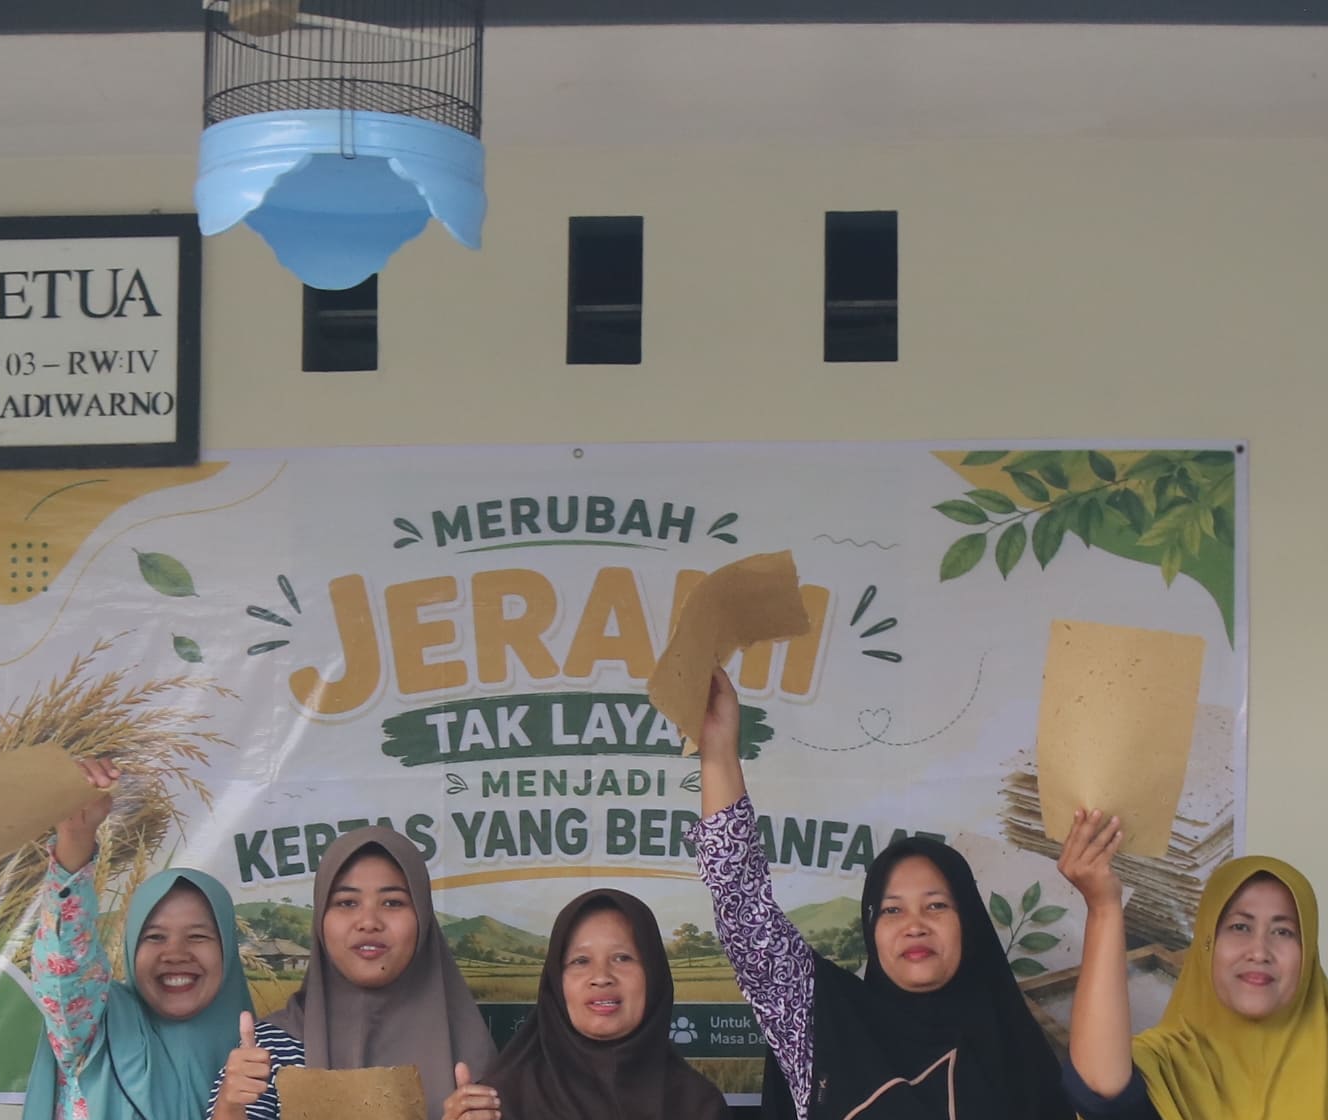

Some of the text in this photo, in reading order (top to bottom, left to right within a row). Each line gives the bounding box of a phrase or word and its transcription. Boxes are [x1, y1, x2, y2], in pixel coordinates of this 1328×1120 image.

[431, 495, 696, 548] MERUBAH
[424, 702, 682, 754] TAK LAYA
[480, 768, 667, 799] MENJADI
[451, 808, 588, 859] YANG
[710, 1015, 752, 1029] Untuk
[710, 1032, 745, 1045] Masa
